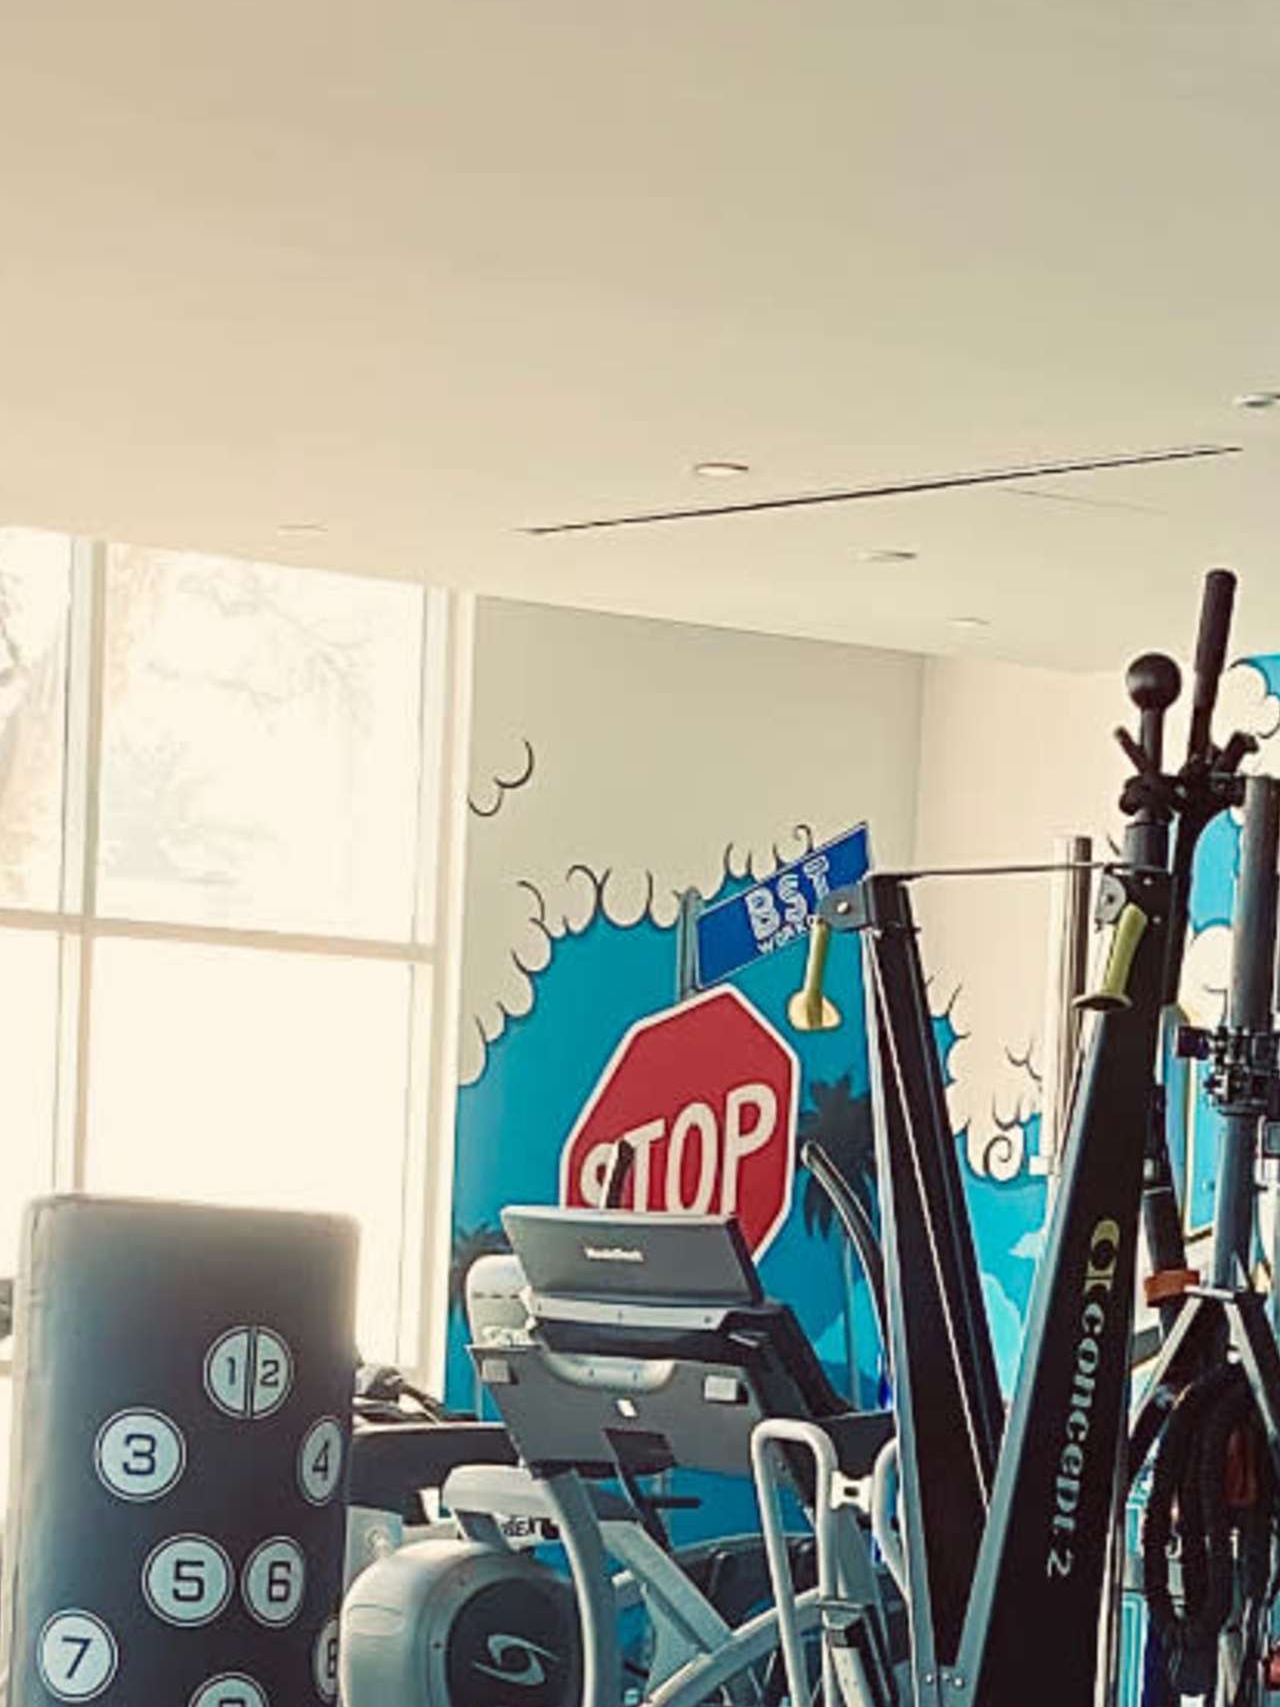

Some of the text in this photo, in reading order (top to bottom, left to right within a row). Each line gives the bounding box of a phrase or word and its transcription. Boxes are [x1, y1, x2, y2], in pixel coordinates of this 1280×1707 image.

[226, 1356, 237, 1386] 1
[259, 1359, 280, 1387] 2
[122, 1433, 157, 1477] 3
[312, 1439, 330, 1482] 4
[171, 1558, 206, 1603] 5
[267, 1560, 293, 1603] 6
[1046, 1547, 1074, 1579] 2
[61, 1636, 91, 1680] 7
